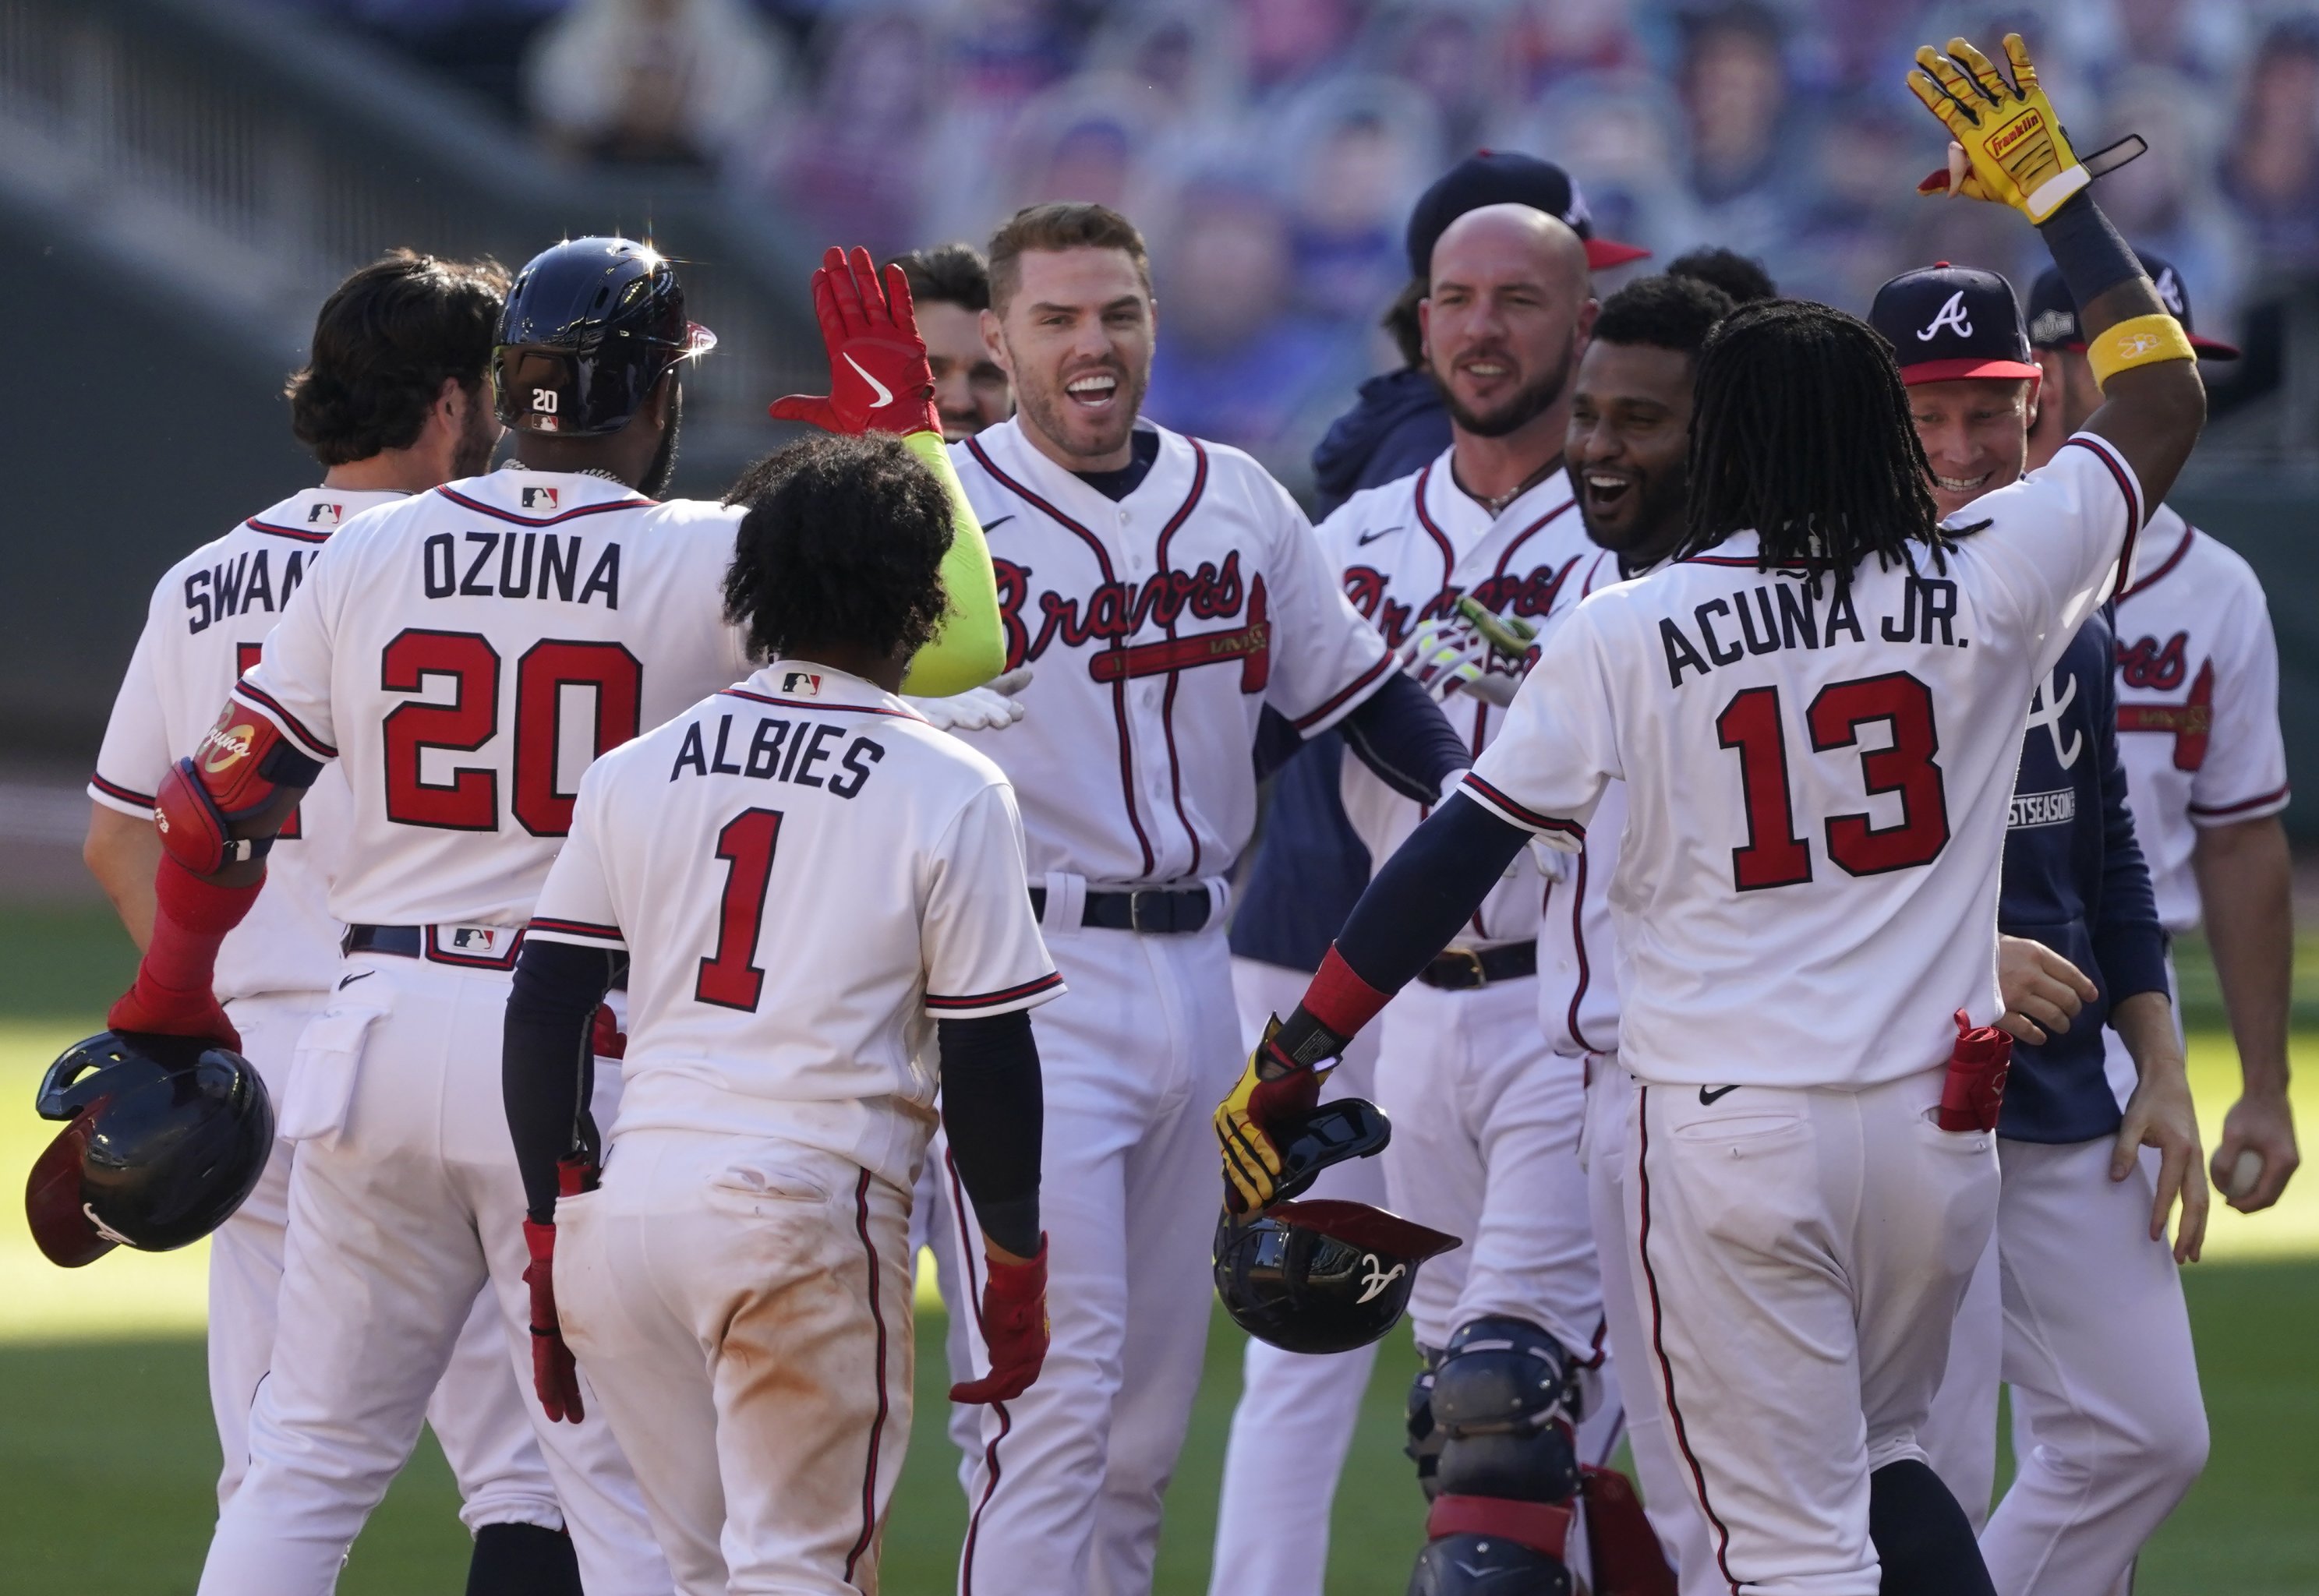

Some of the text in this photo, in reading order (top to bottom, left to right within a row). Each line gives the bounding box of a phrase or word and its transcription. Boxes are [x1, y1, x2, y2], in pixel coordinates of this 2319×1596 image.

[1917, 291, 1973, 341] A
[532, 388, 557, 413] 20
[424, 531, 620, 610] OZUNA
[1659, 570, 1968, 689] ACUÑA JR.
[381, 627, 643, 837] 20
[670, 715, 885, 799] ALBIES
[1716, 670, 1950, 892] 13
[695, 807, 784, 1013] 1
